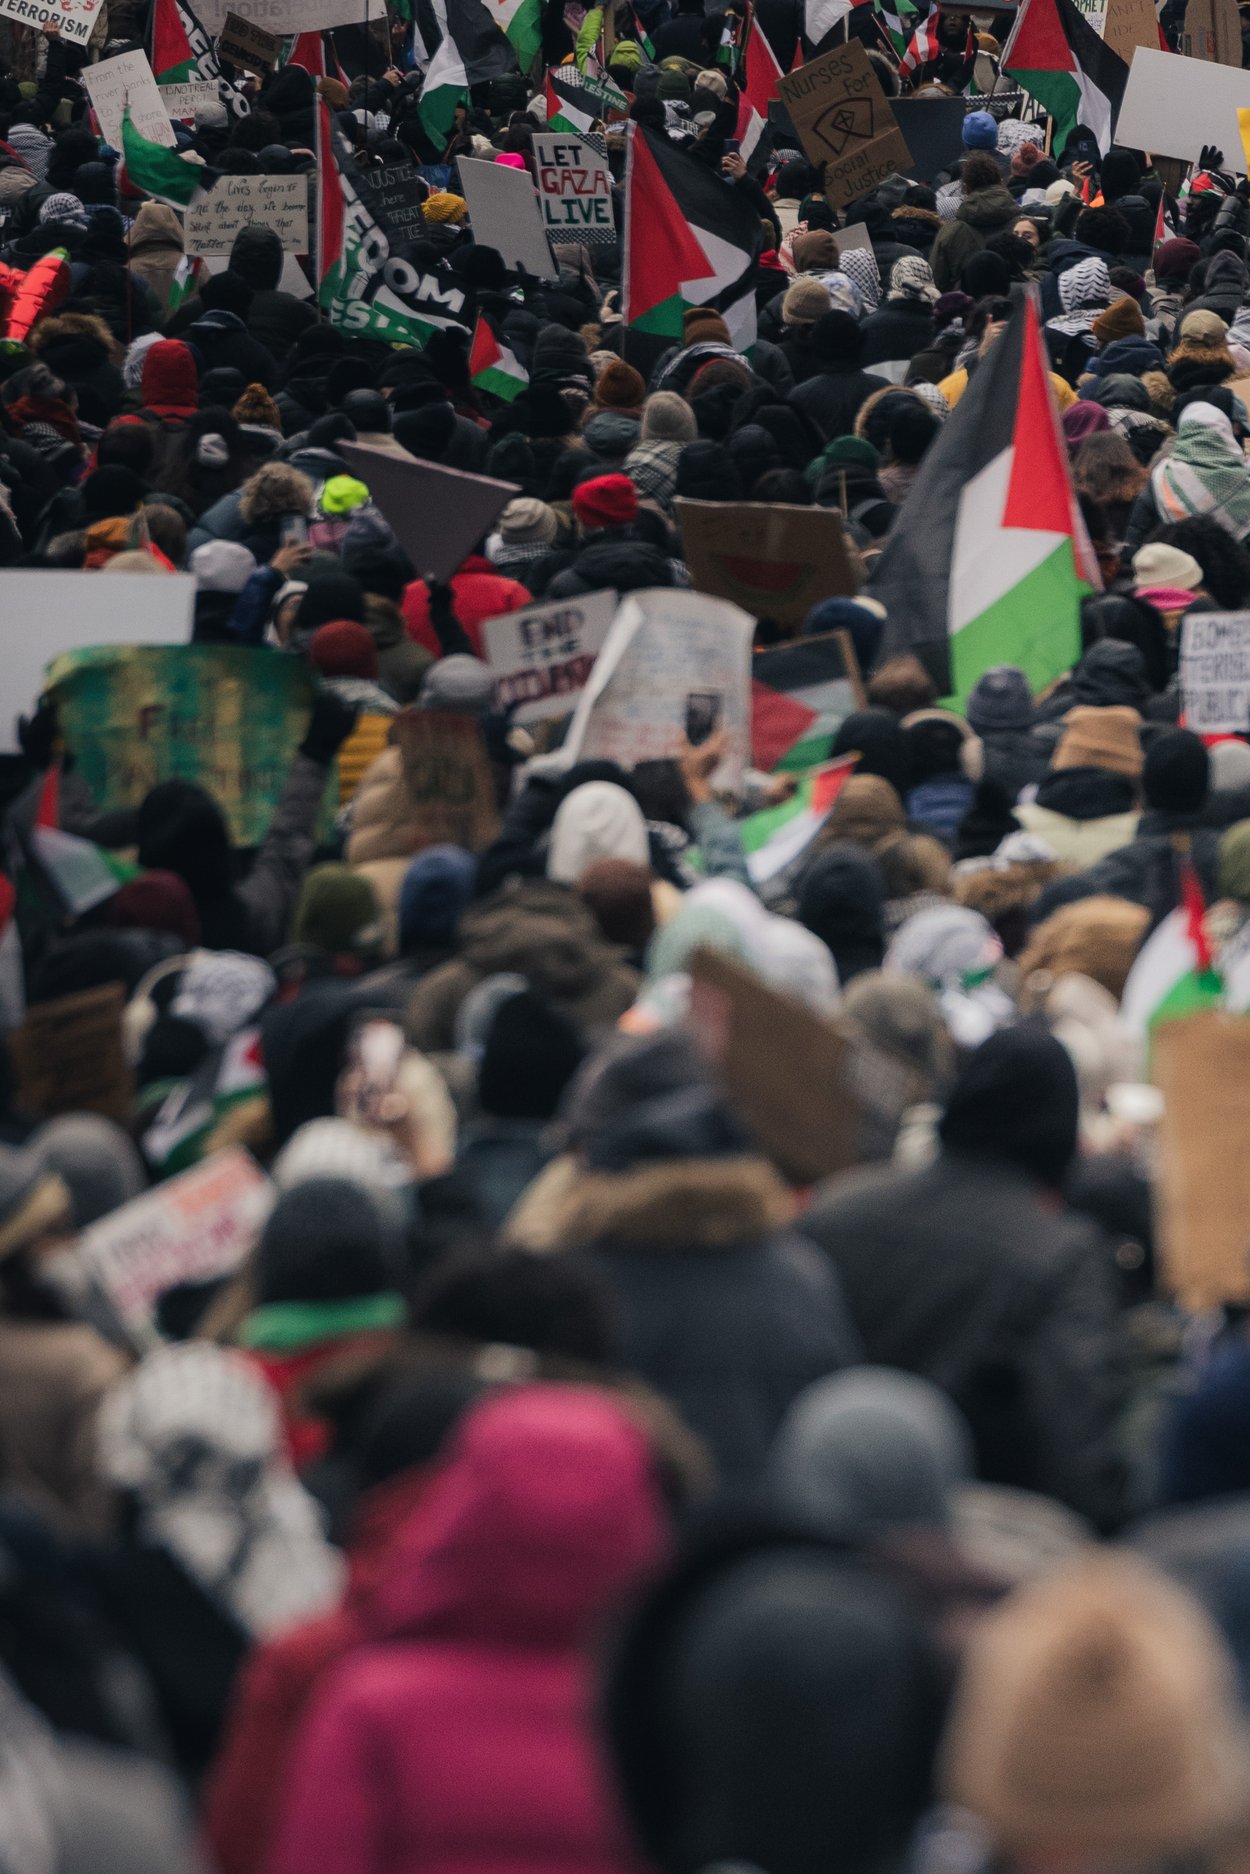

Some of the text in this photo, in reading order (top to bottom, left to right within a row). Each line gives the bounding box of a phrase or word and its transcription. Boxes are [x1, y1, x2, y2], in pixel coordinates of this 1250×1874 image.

[0, 0, 88, 38] ERRORISM
[88, 62, 136, 86] From the
[781, 55, 853, 104] Nurses
[95, 87, 119, 101] river
[194, 82, 216, 93] REAL
[538, 145, 582, 167] LET
[540, 168, 610, 195] GAZA
[842, 159, 897, 198] Justice
[237, 200, 256, 220] day
[544, 198, 610, 225] LIVE
